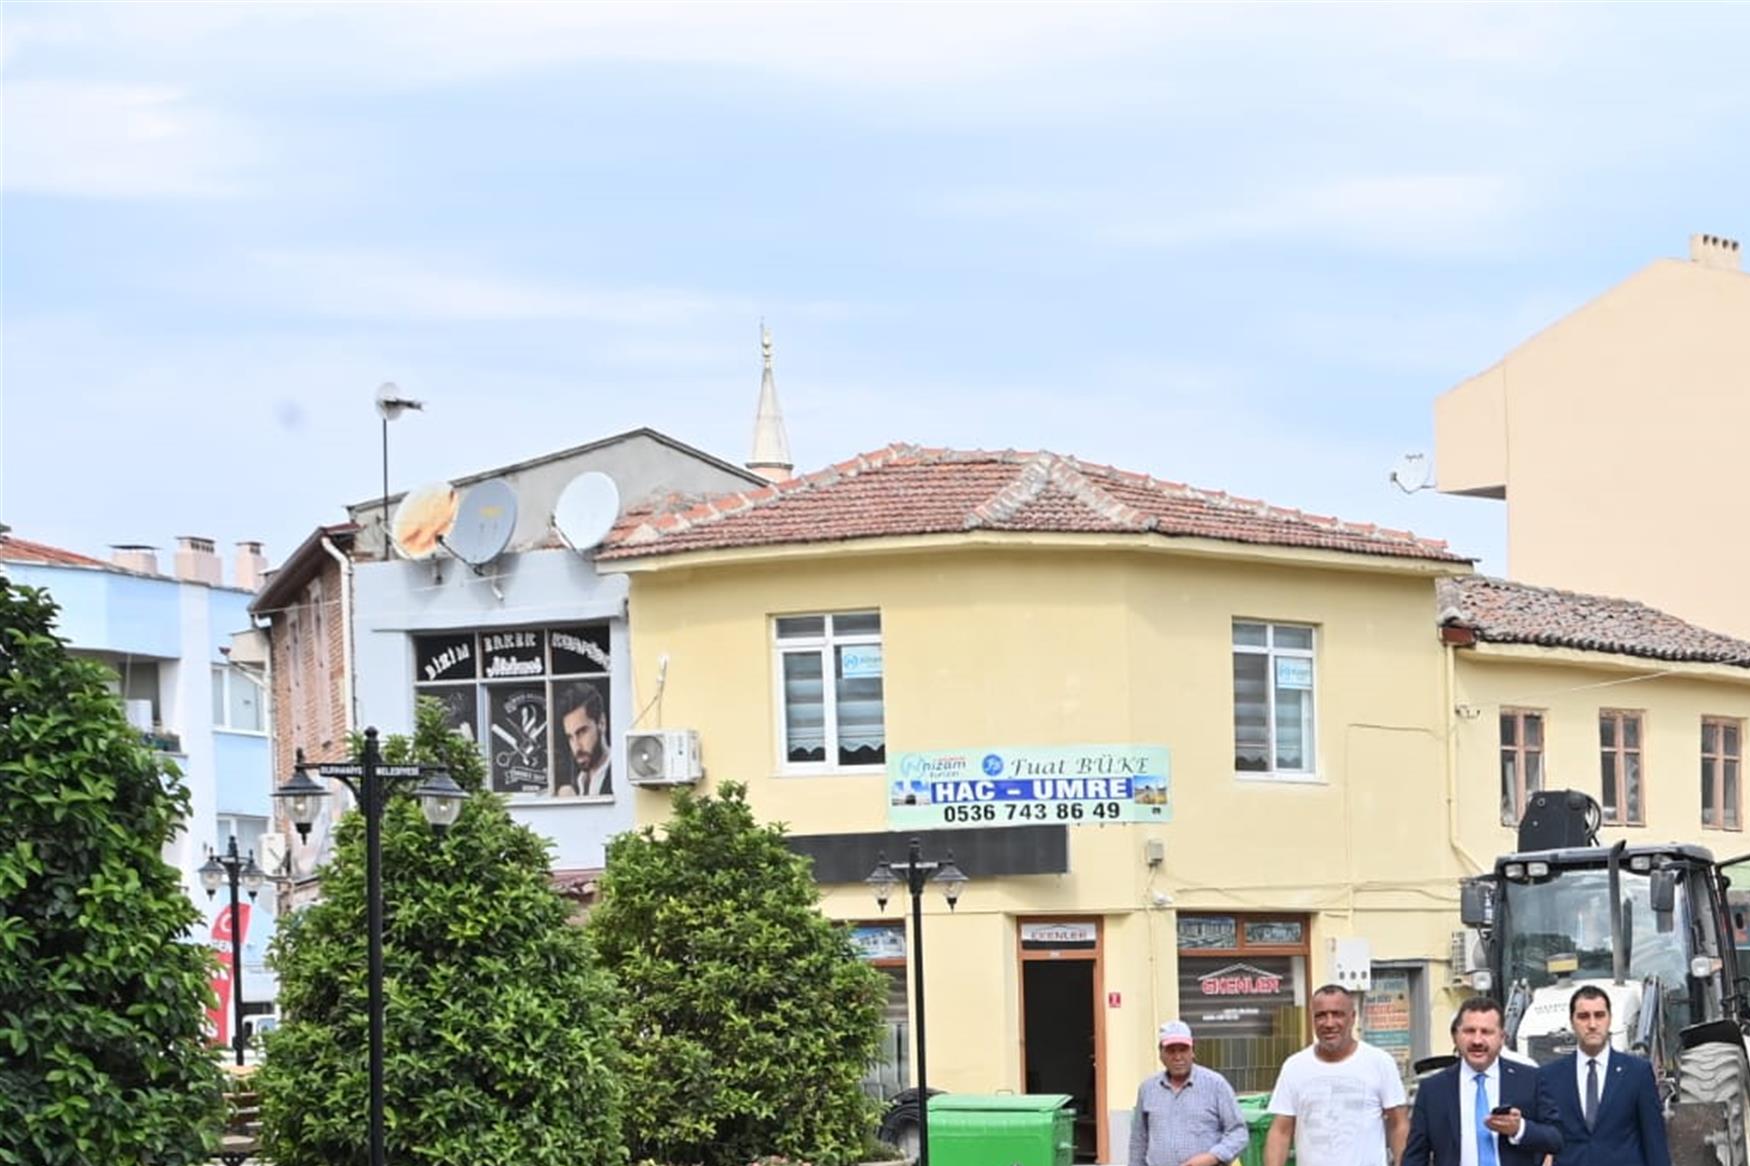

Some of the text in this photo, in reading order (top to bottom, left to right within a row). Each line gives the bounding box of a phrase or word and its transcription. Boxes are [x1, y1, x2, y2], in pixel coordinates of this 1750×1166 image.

[935, 780, 996, 802] HAC
[1032, 777, 1127, 799] UMRE
[943, 801, 1120, 823] 0536 743 86 49
